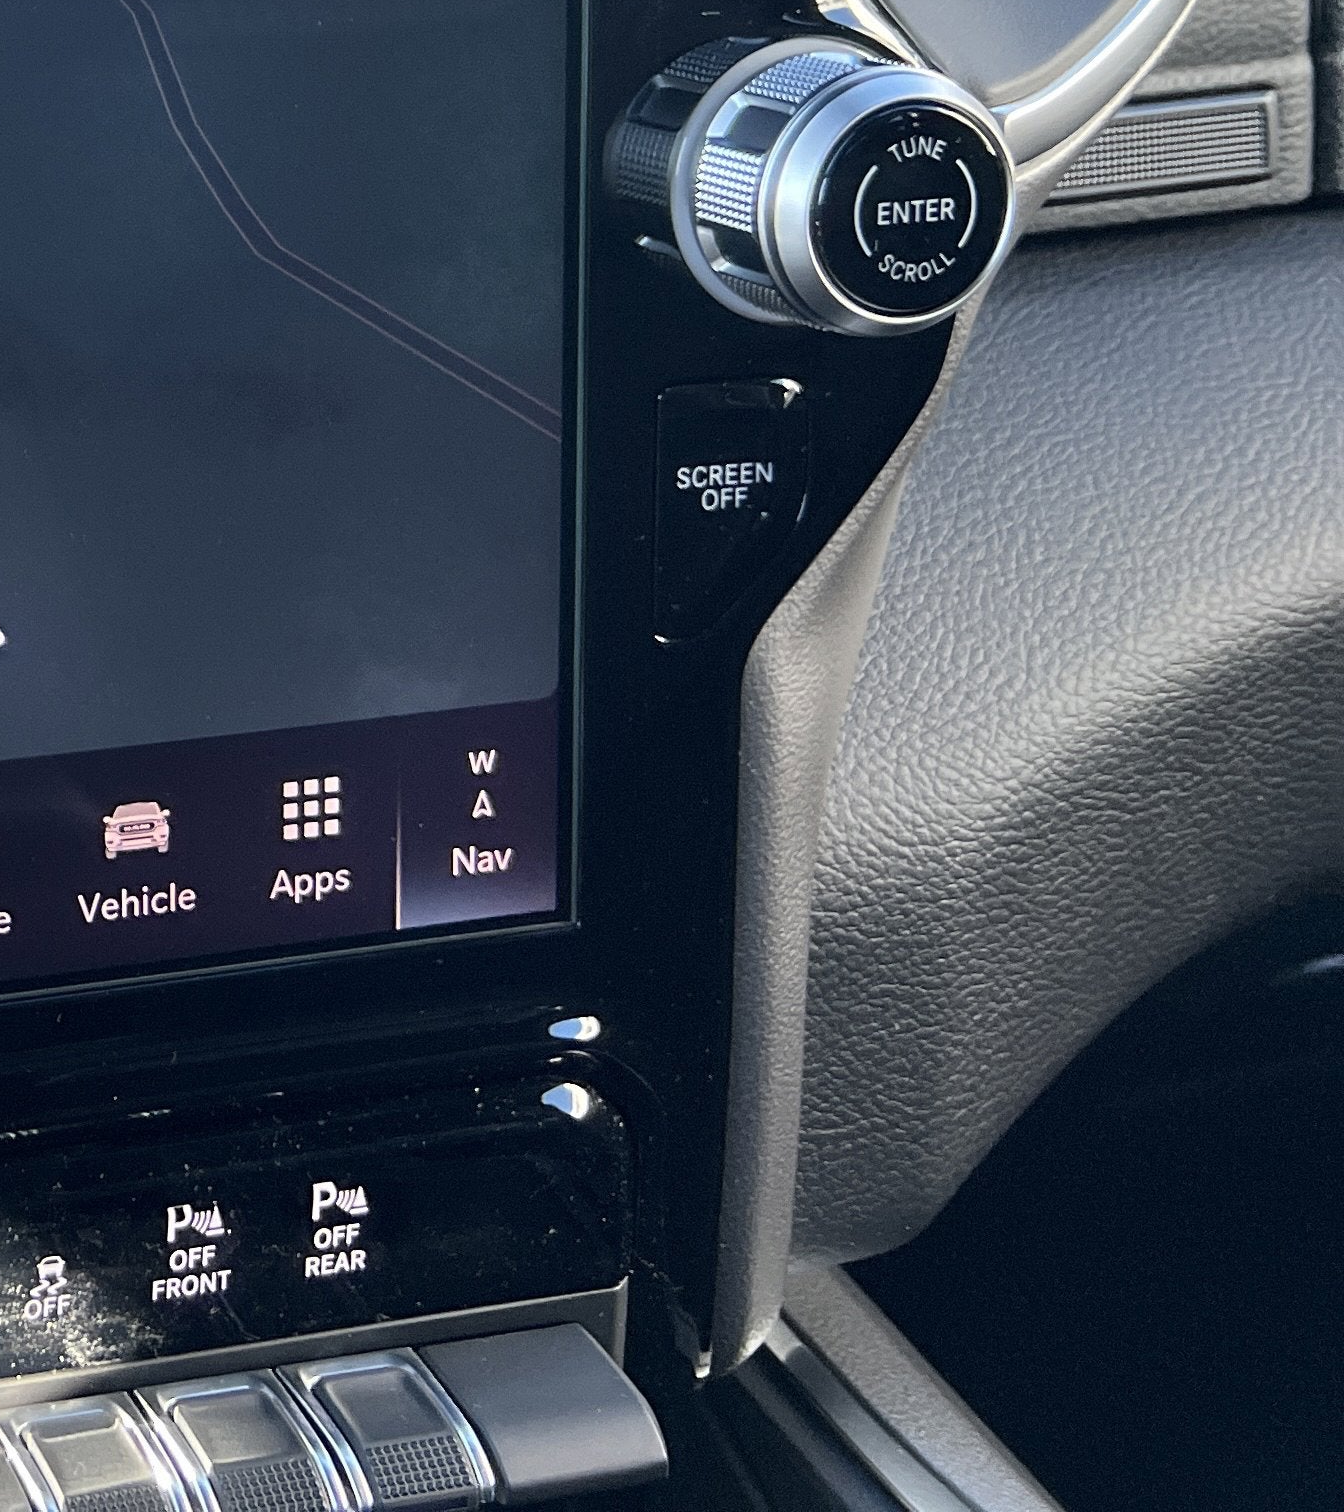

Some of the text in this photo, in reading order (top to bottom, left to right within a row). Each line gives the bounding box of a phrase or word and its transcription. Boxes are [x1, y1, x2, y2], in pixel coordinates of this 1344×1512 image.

[886, 135, 949, 162] TUNE
[876, 196, 956, 226] ENTER
[877, 250, 957, 284] SCROLL
[675, 461, 774, 489] SCREEN
[699, 486, 749, 511] OFF
[467, 749, 497, 774] W
[451, 845, 513, 878] Nav
[269, 865, 351, 903] Apps
[77, 883, 197, 923] Vehicle
[313, 1222, 361, 1250] OFF
[168, 1244, 217, 1273] OFF
[304, 1249, 367, 1279] REAR
[152, 1268, 232, 1302] FRONT
[23, 1293, 72, 1322] OFF
